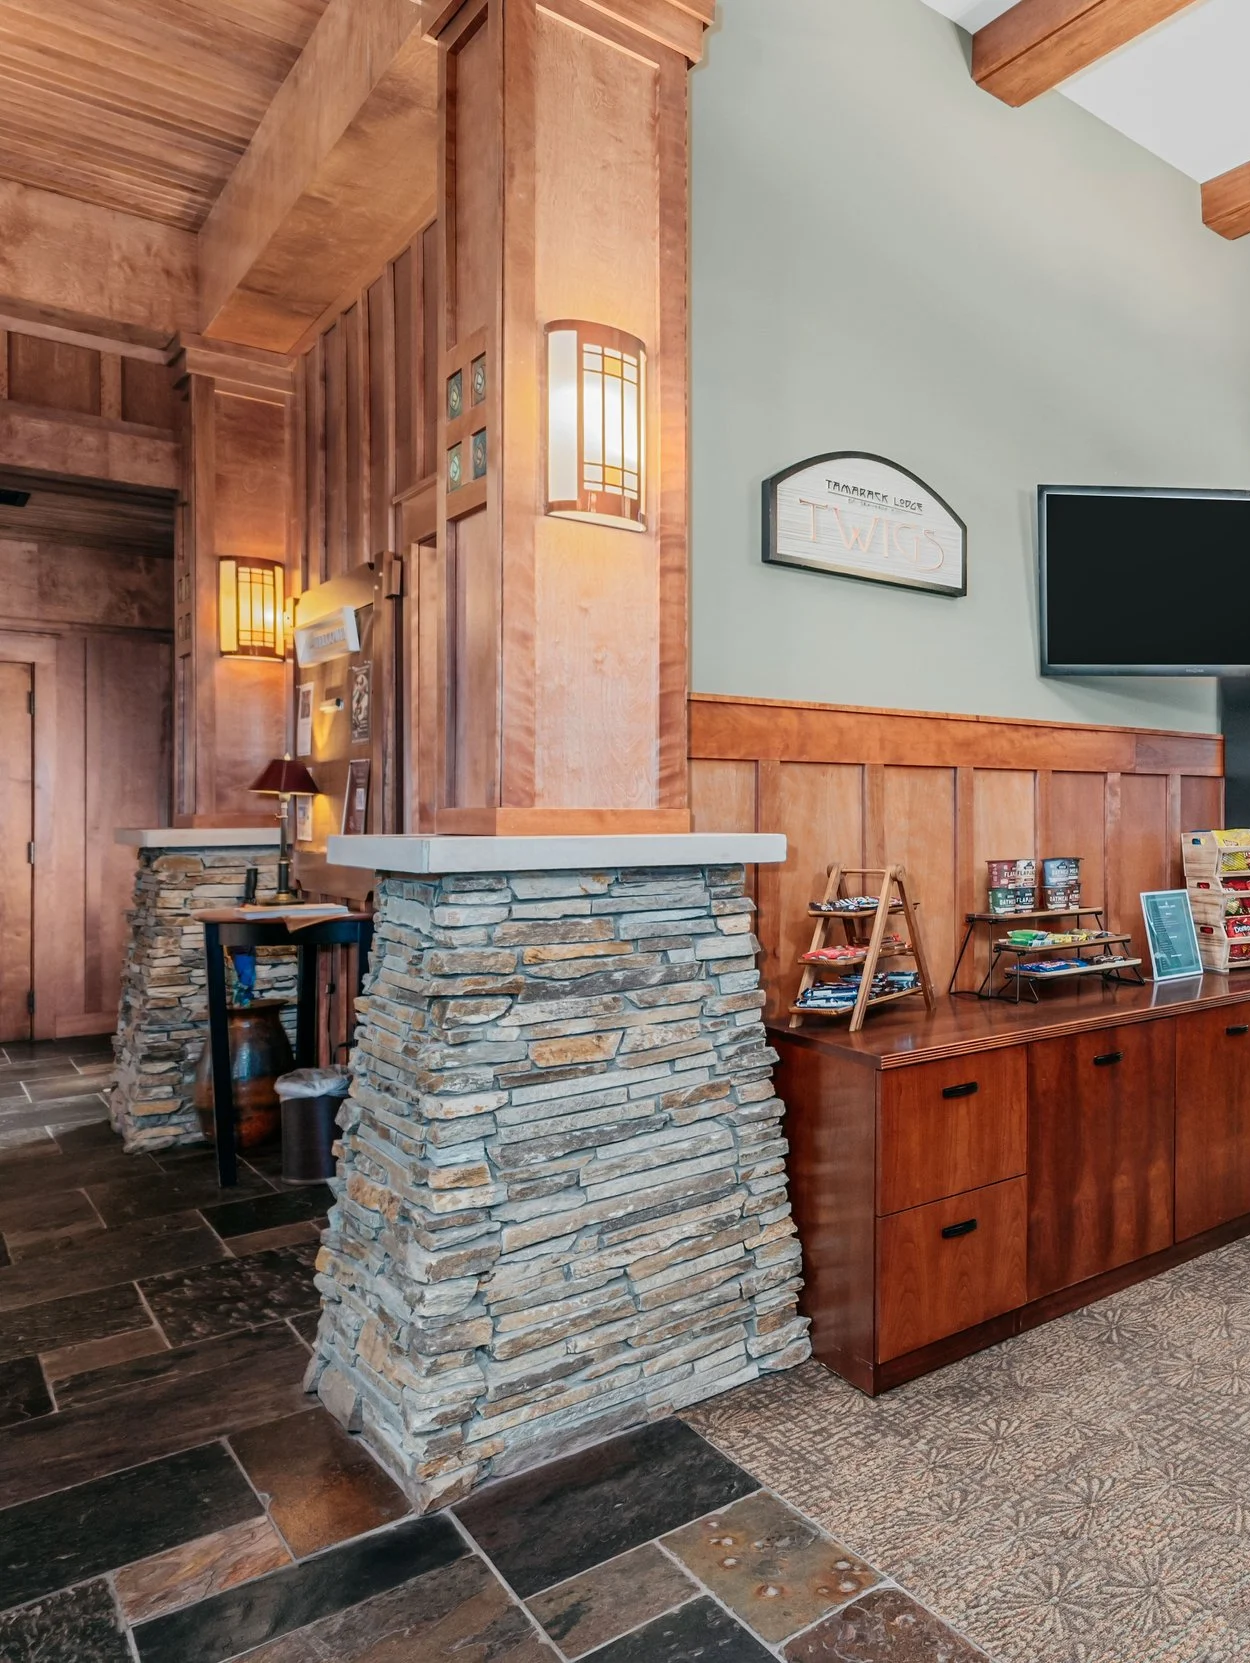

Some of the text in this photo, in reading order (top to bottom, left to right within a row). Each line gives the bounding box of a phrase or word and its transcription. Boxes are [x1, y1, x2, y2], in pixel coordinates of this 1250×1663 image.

[825, 479, 888, 503] TAMARACK
[893, 497, 923, 512] LODGE
[798, 498, 945, 574] TWIGS
